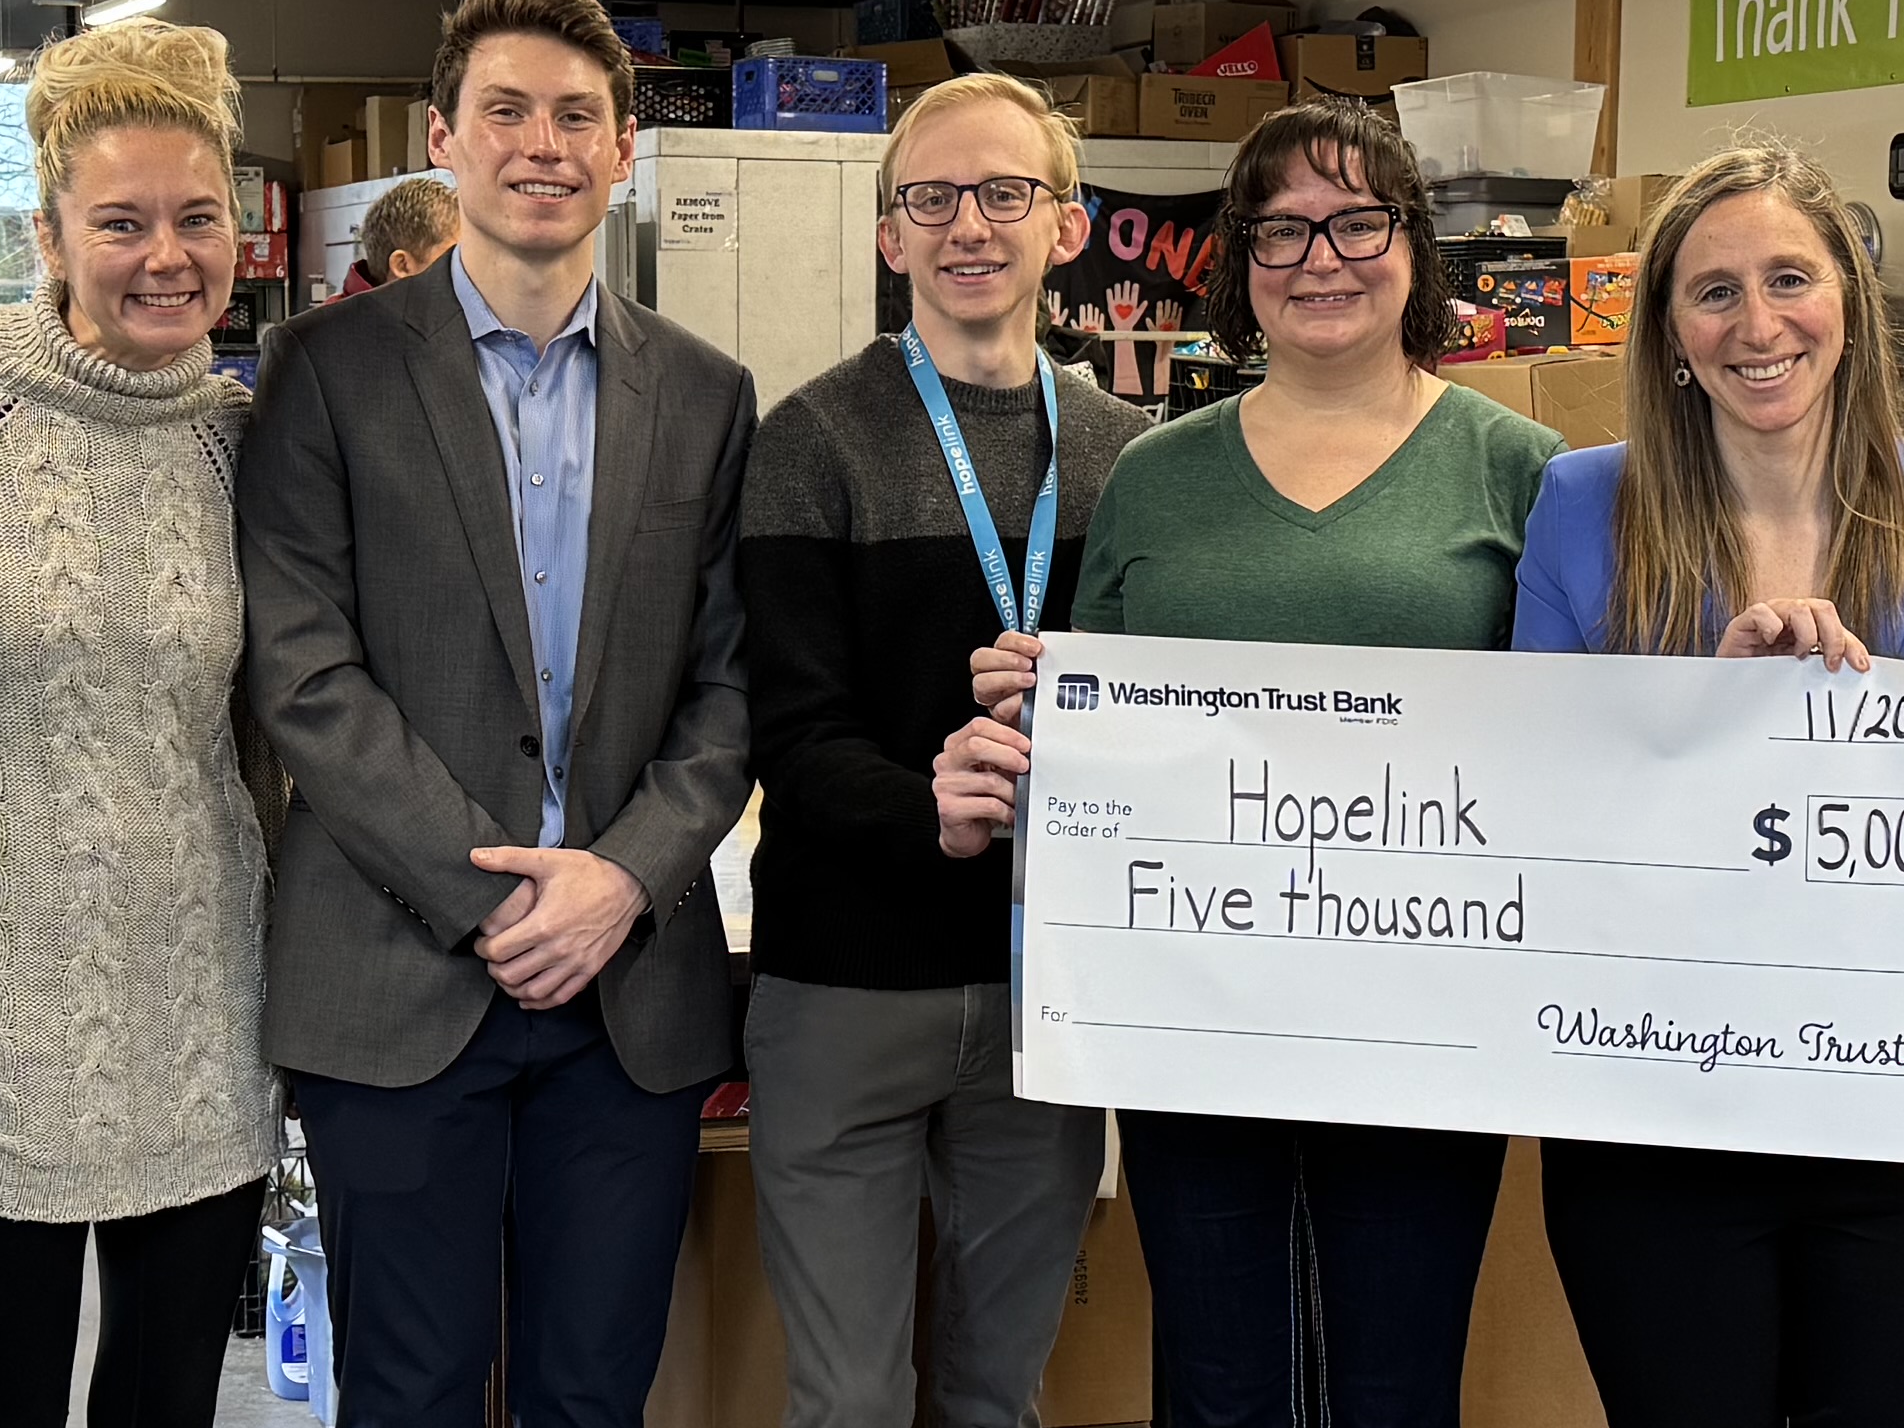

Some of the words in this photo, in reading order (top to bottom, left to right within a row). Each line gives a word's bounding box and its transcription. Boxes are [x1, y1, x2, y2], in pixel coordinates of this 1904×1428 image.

[1179, 106, 1209, 119] OVEN
[676, 198, 720, 207] REMOVE
[671, 211, 699, 221] Paper
[701, 212, 725, 221] from
[682, 224, 714, 233] Crates
[1504, 313, 1545, 328] Doritos
[934, 413, 976, 496] hopelink
[1107, 681, 1260, 717] Washington
[1262, 687, 1327, 714] Trust
[1333, 690, 1403, 716] Bank
[1339, 716, 1374, 724] Member
[1375, 717, 1399, 725] FDIC
[1047, 796, 1077, 818] Pay
[1082, 800, 1099, 816] to
[1104, 799, 1133, 817] the
[1045, 820, 1096, 838] Order
[1101, 821, 1119, 838] of
[1228, 757, 1488, 883] Hopelink
[1752, 804, 1793, 865] $
[1127, 859, 1255, 933] Five
[1279, 866, 1525, 944] thousand
[1040, 1004, 1069, 1024] For
[1537, 1004, 1785, 1073] Washington
